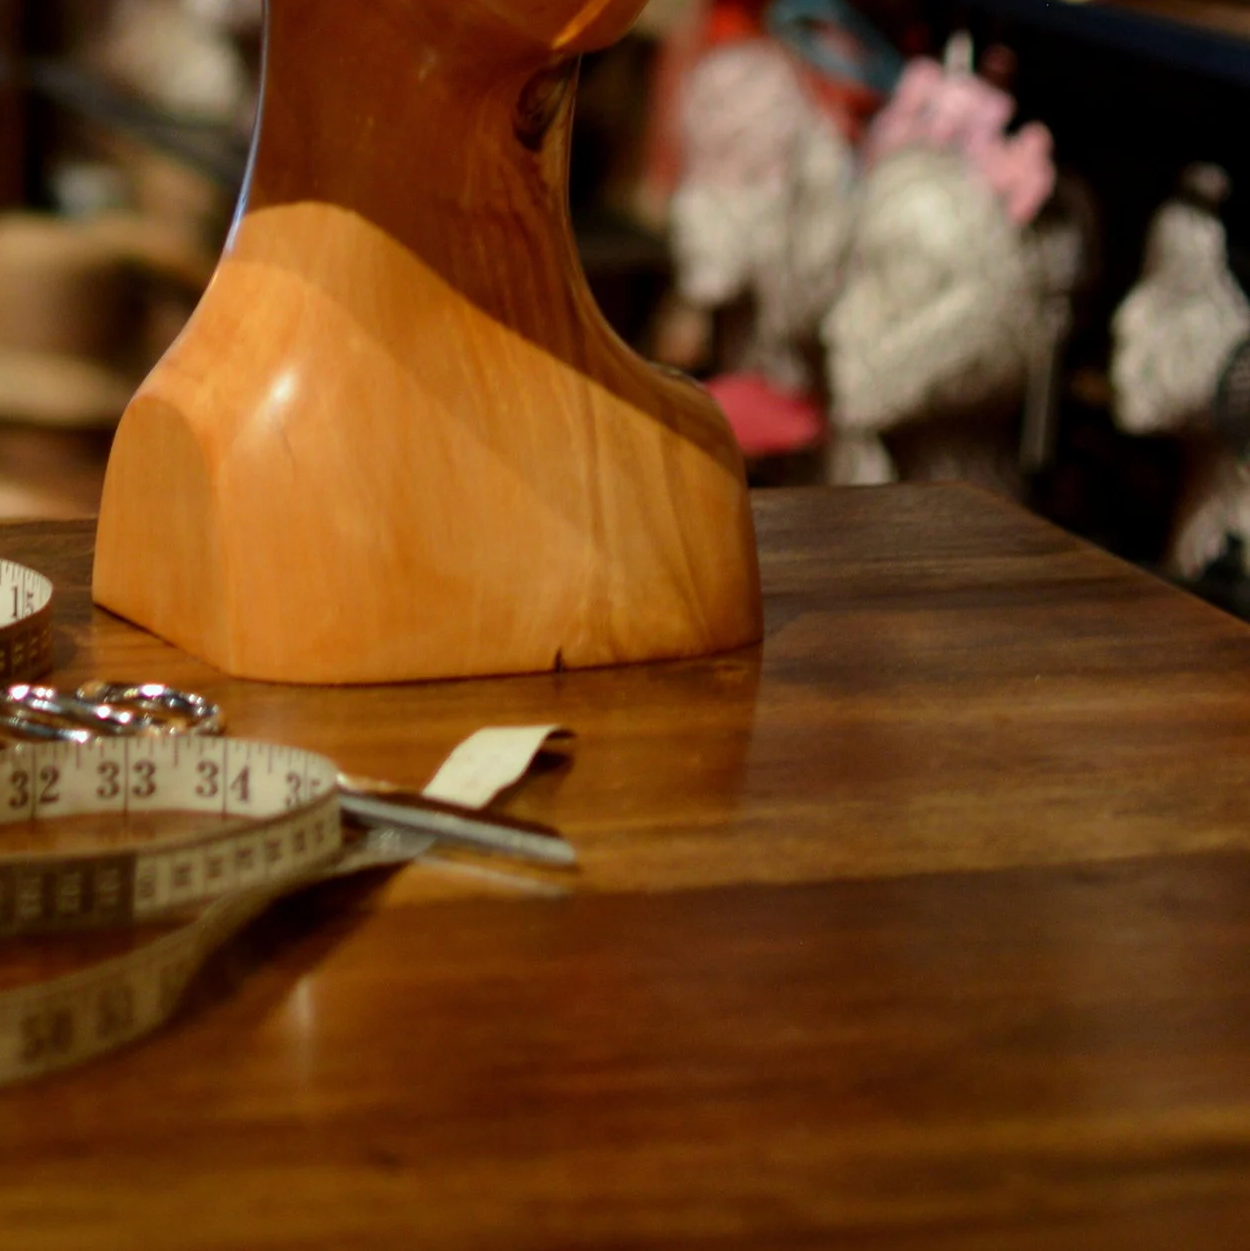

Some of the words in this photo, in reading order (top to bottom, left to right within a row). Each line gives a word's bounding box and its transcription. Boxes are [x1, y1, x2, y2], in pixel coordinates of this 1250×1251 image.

[11, 583, 36, 621] 15
[7, 763, 60, 810] 32
[95, 759, 157, 800] 33
[194, 760, 250, 802] 34
